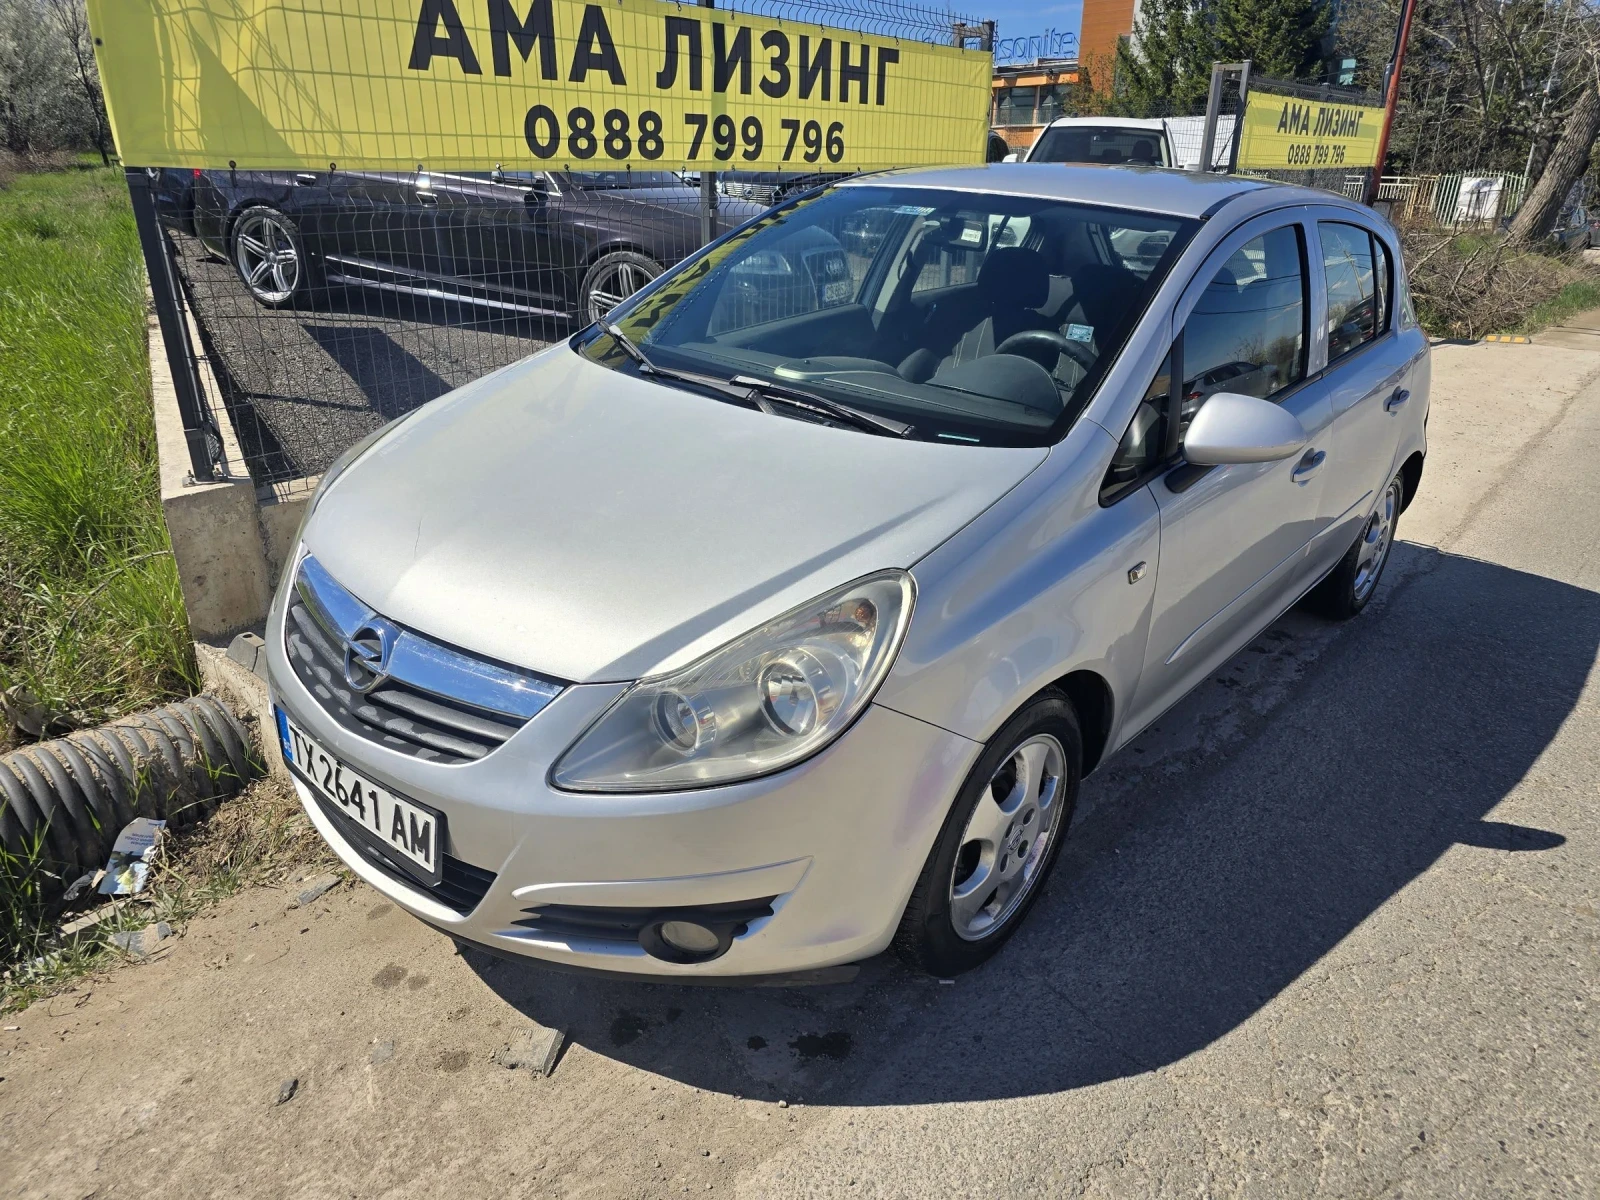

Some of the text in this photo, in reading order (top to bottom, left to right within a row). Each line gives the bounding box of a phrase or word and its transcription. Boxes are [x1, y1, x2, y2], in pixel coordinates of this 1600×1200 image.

[408, 0, 900, 106] АМА ЛИЗИНГ
[524, 104, 845, 163] 0888 799 796
[1277, 101, 1364, 138] АМА ЛИЗИНГ
[1287, 143, 1346, 165] 0888 799 796
[289, 724, 431, 865] TX 2641 AM
